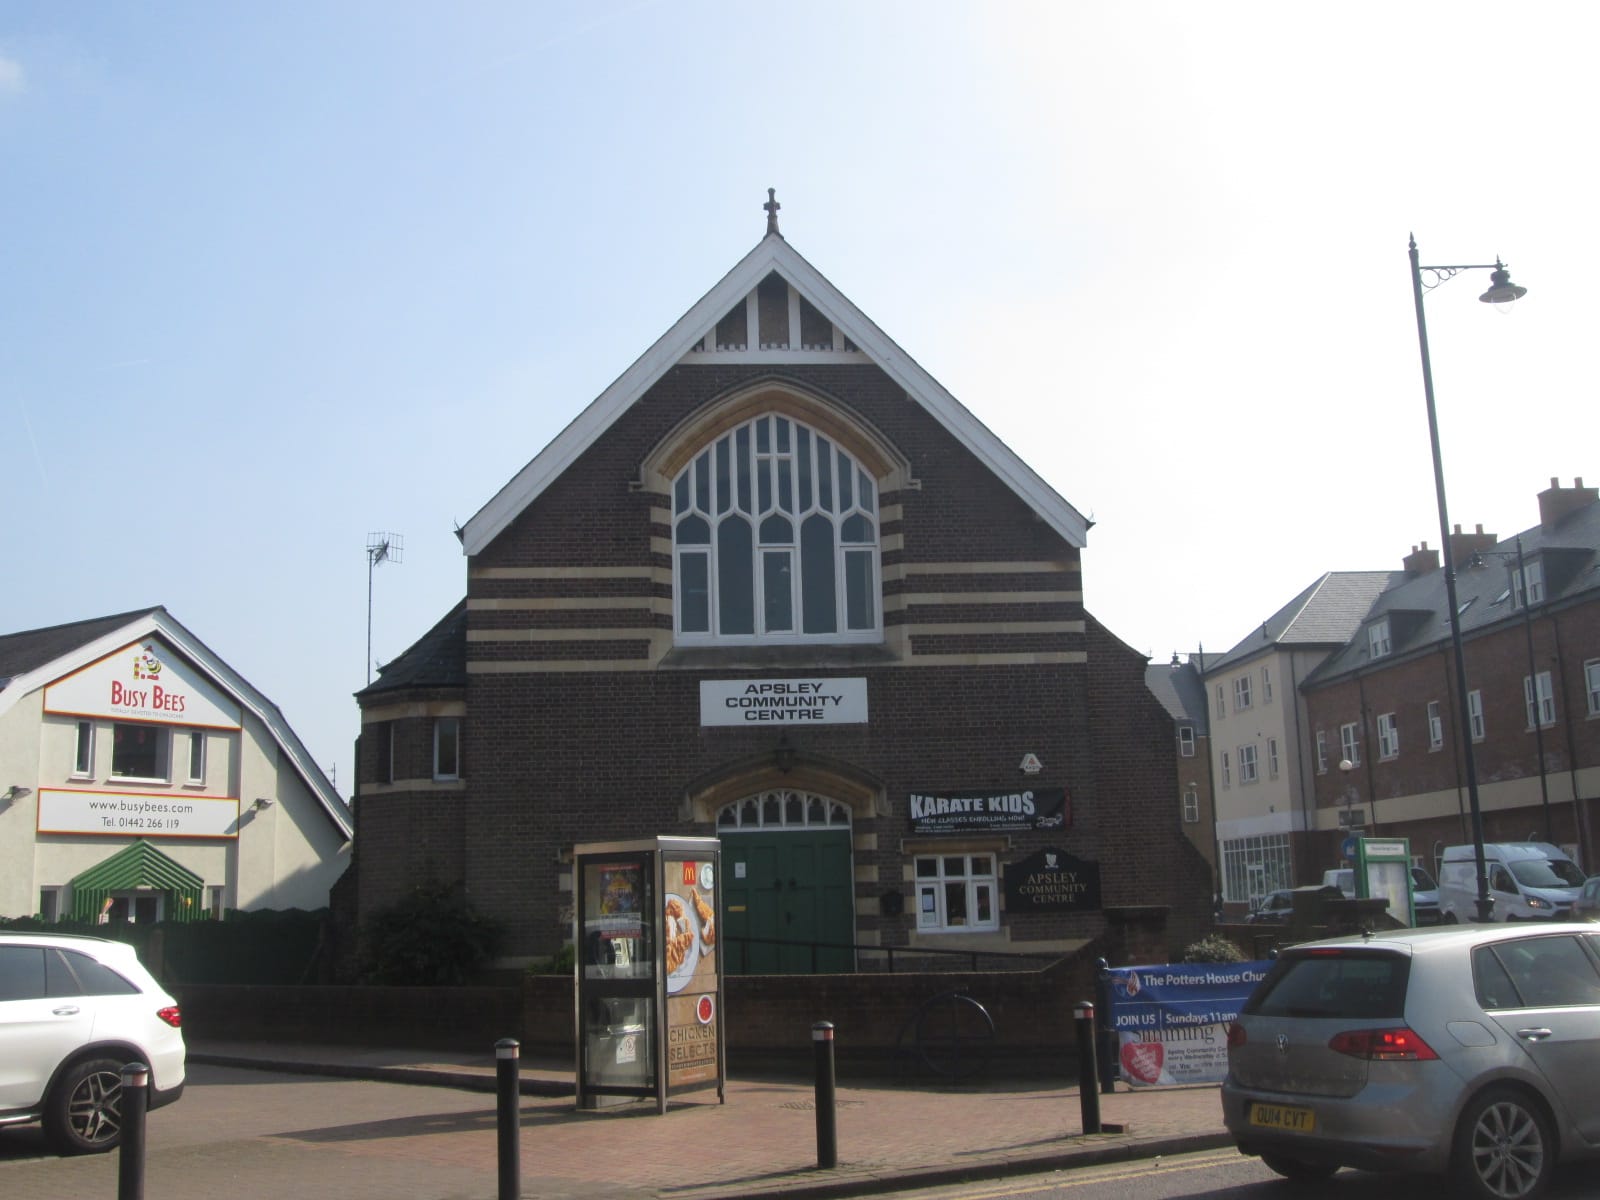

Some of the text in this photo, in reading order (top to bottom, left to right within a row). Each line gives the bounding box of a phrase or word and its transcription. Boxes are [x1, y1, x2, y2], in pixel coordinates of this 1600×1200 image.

[744, 683, 823, 695] APSLEY
[725, 695, 843, 708] COMMUNITY
[744, 708, 824, 721] CENTRE
[89, 800, 193, 814] www.busybees.com
[910, 791, 1035, 819] KARATE KIDS
[101, 817, 180, 829] Tel. 01442 266 119
[1027, 872, 1077, 884] APSLEY
[1019, 883, 1087, 895] COMMUNITY
[1033, 894, 1074, 904] CENTRE
[1144, 974, 1164, 987] The
[1166, 973, 1205, 985] Potters
[1207, 972, 1240, 984] House
[1116, 1011, 1237, 1026] JOIN US Sundays 11am
[670, 1025, 715, 1043] CHICKEN
[670, 1042, 715, 1061] SELECTS
[1284, 1110, 1307, 1129] CVT
